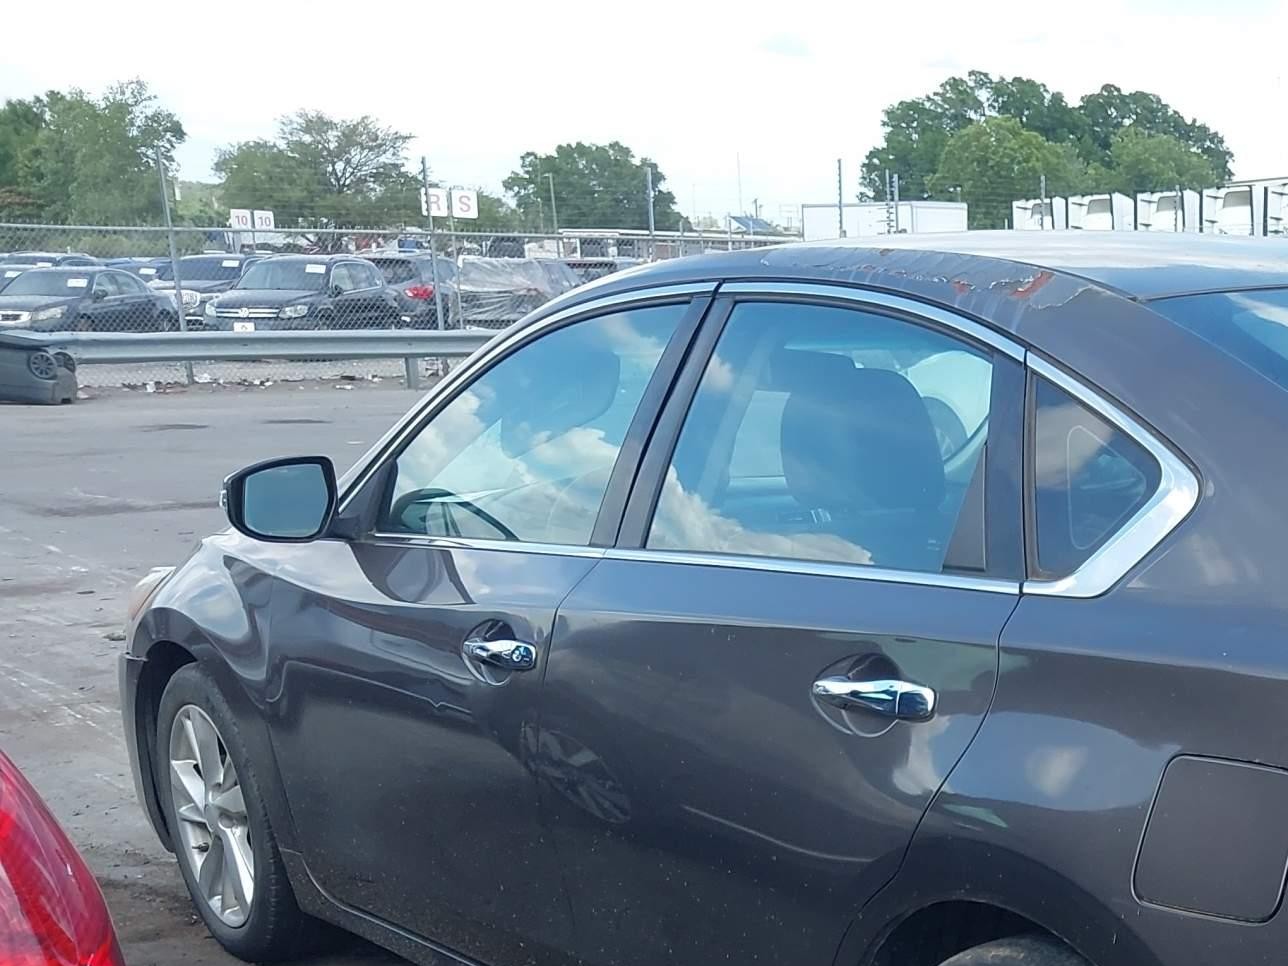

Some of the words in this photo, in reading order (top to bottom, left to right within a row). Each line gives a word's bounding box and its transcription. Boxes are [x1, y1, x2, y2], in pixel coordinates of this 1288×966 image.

[458, 195, 472, 213] S
[234, 215, 248, 226] 10
[258, 216, 272, 227] 10
